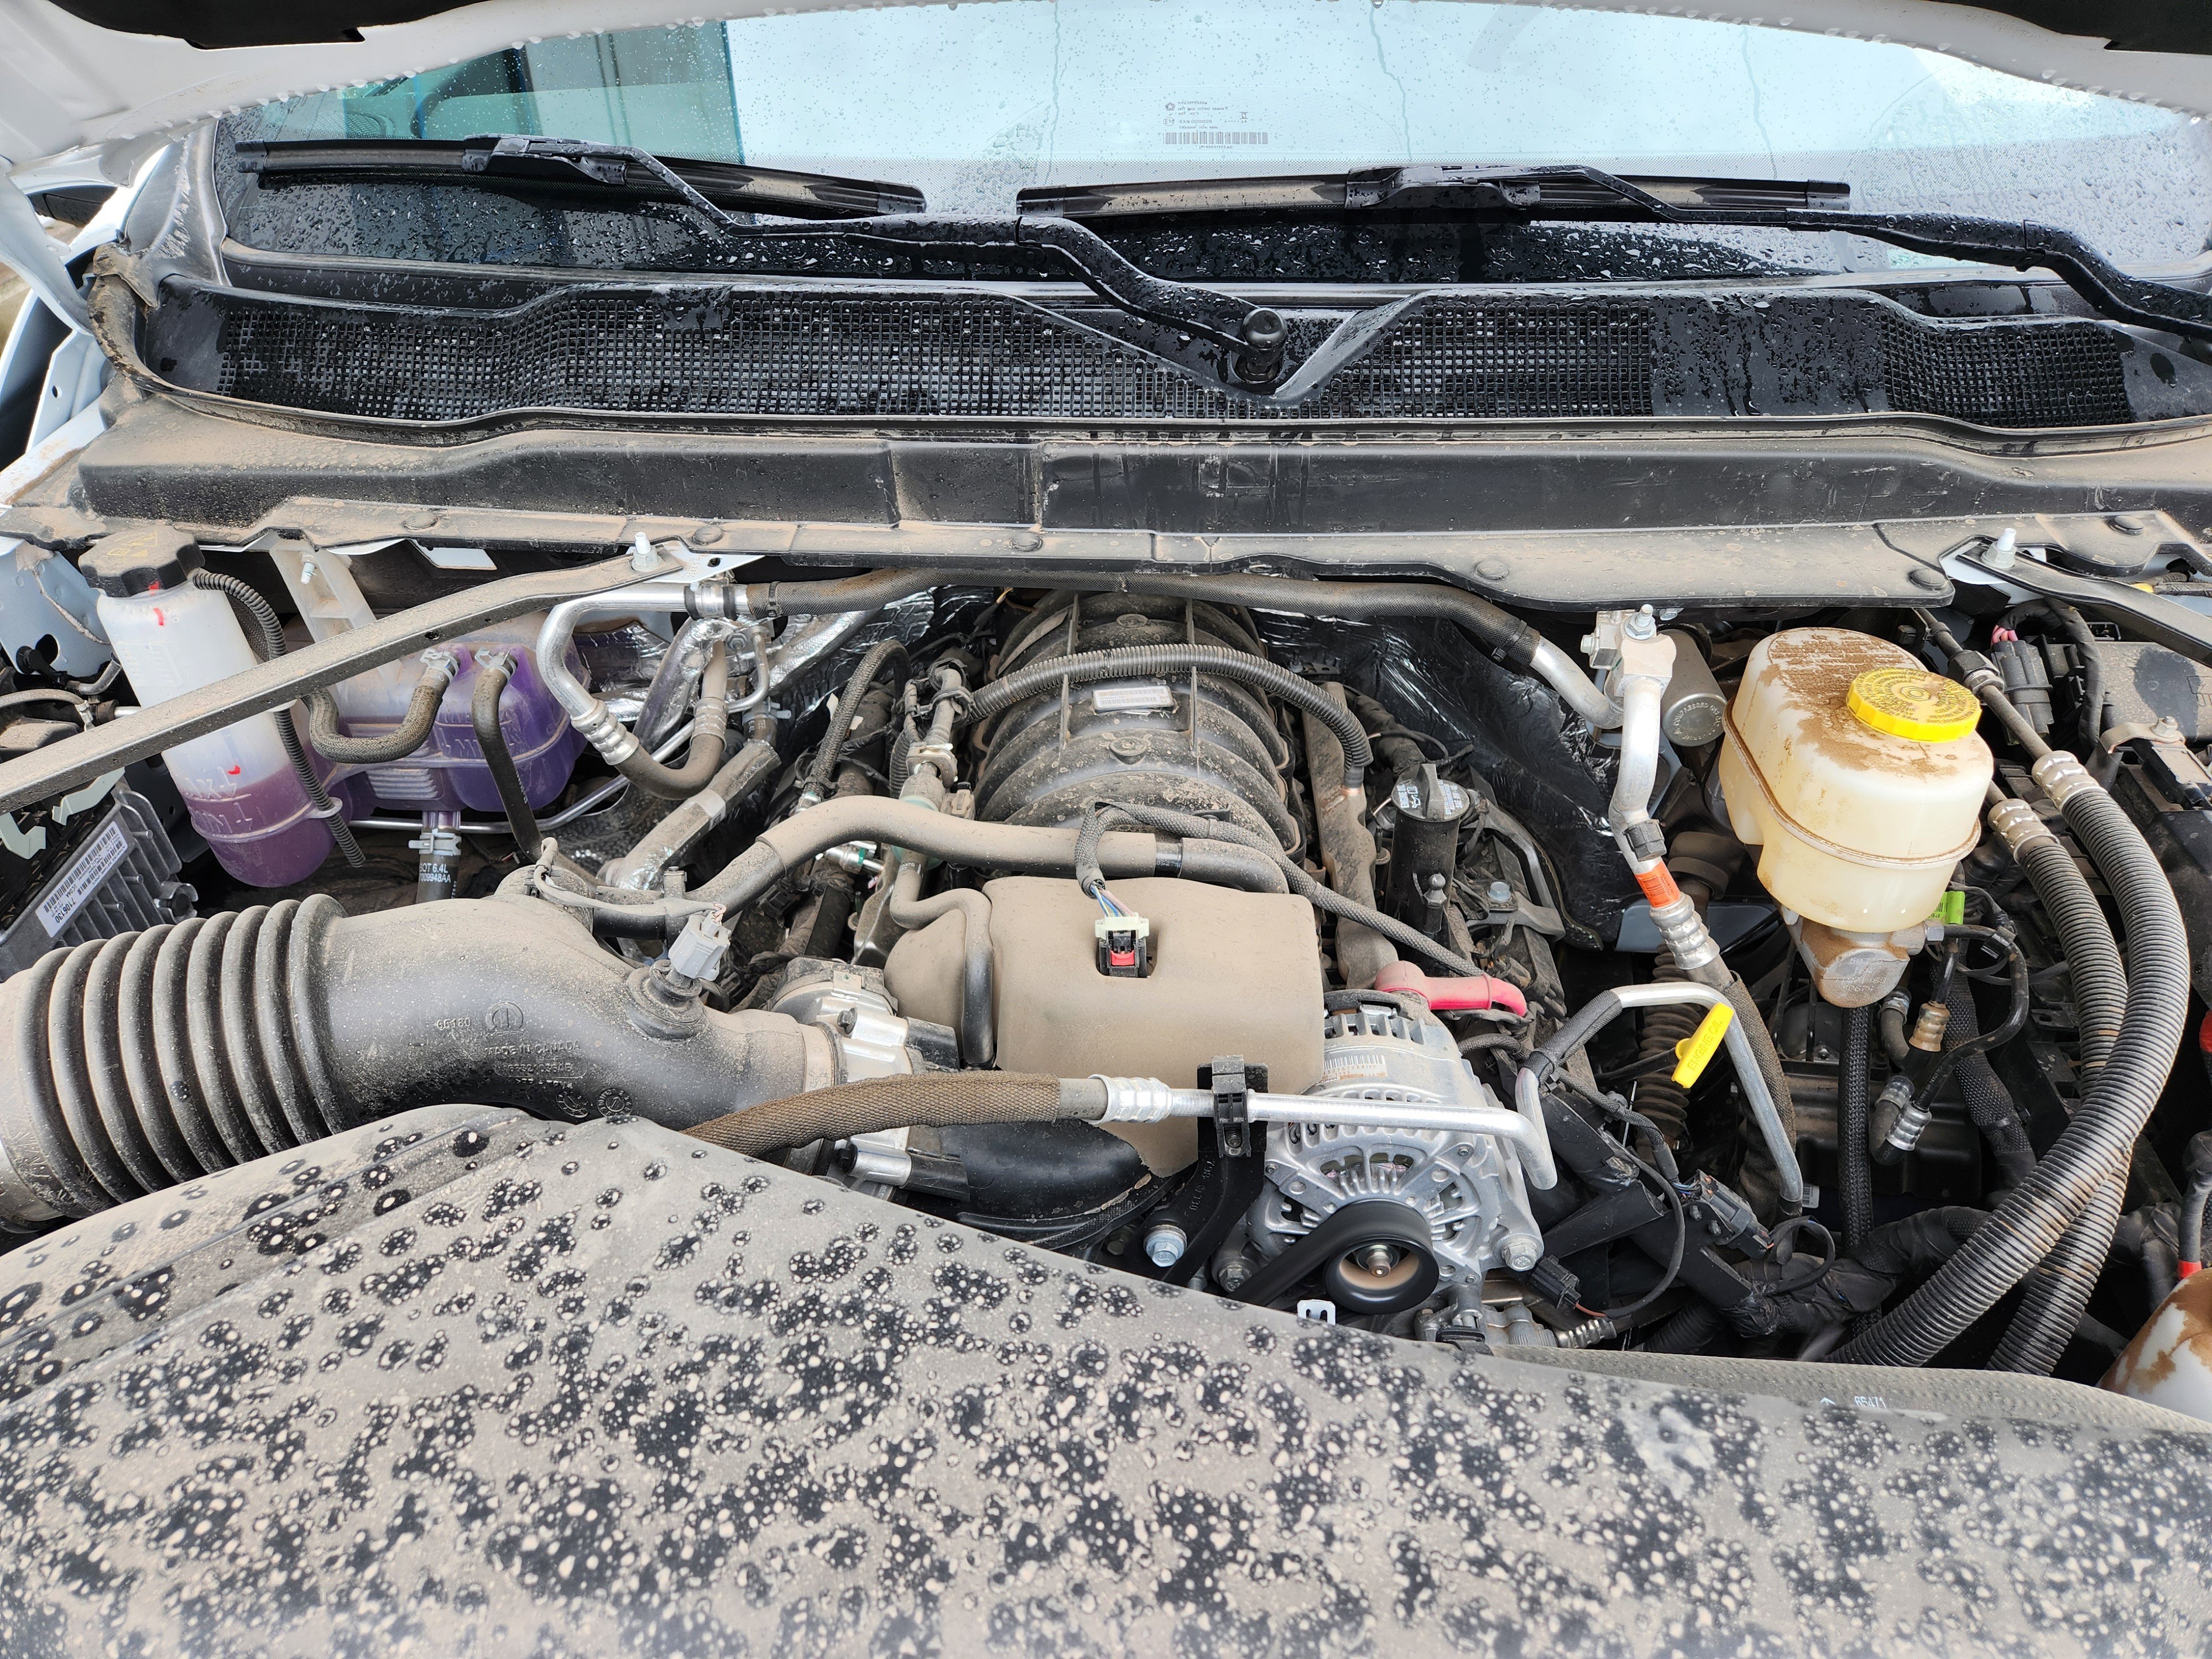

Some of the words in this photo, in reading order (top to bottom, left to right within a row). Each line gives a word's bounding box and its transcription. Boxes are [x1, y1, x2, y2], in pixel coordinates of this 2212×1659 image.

[432, 863, 448, 874] 6.4L
[55, 897, 76, 924] 7106130
[436, 1017, 472, 1031] 66180
[534, 1040, 581, 1055] CANADA
[1687, 1034, 1714, 1071] ENGINE
[1709, 1020, 1724, 1035] OIL
